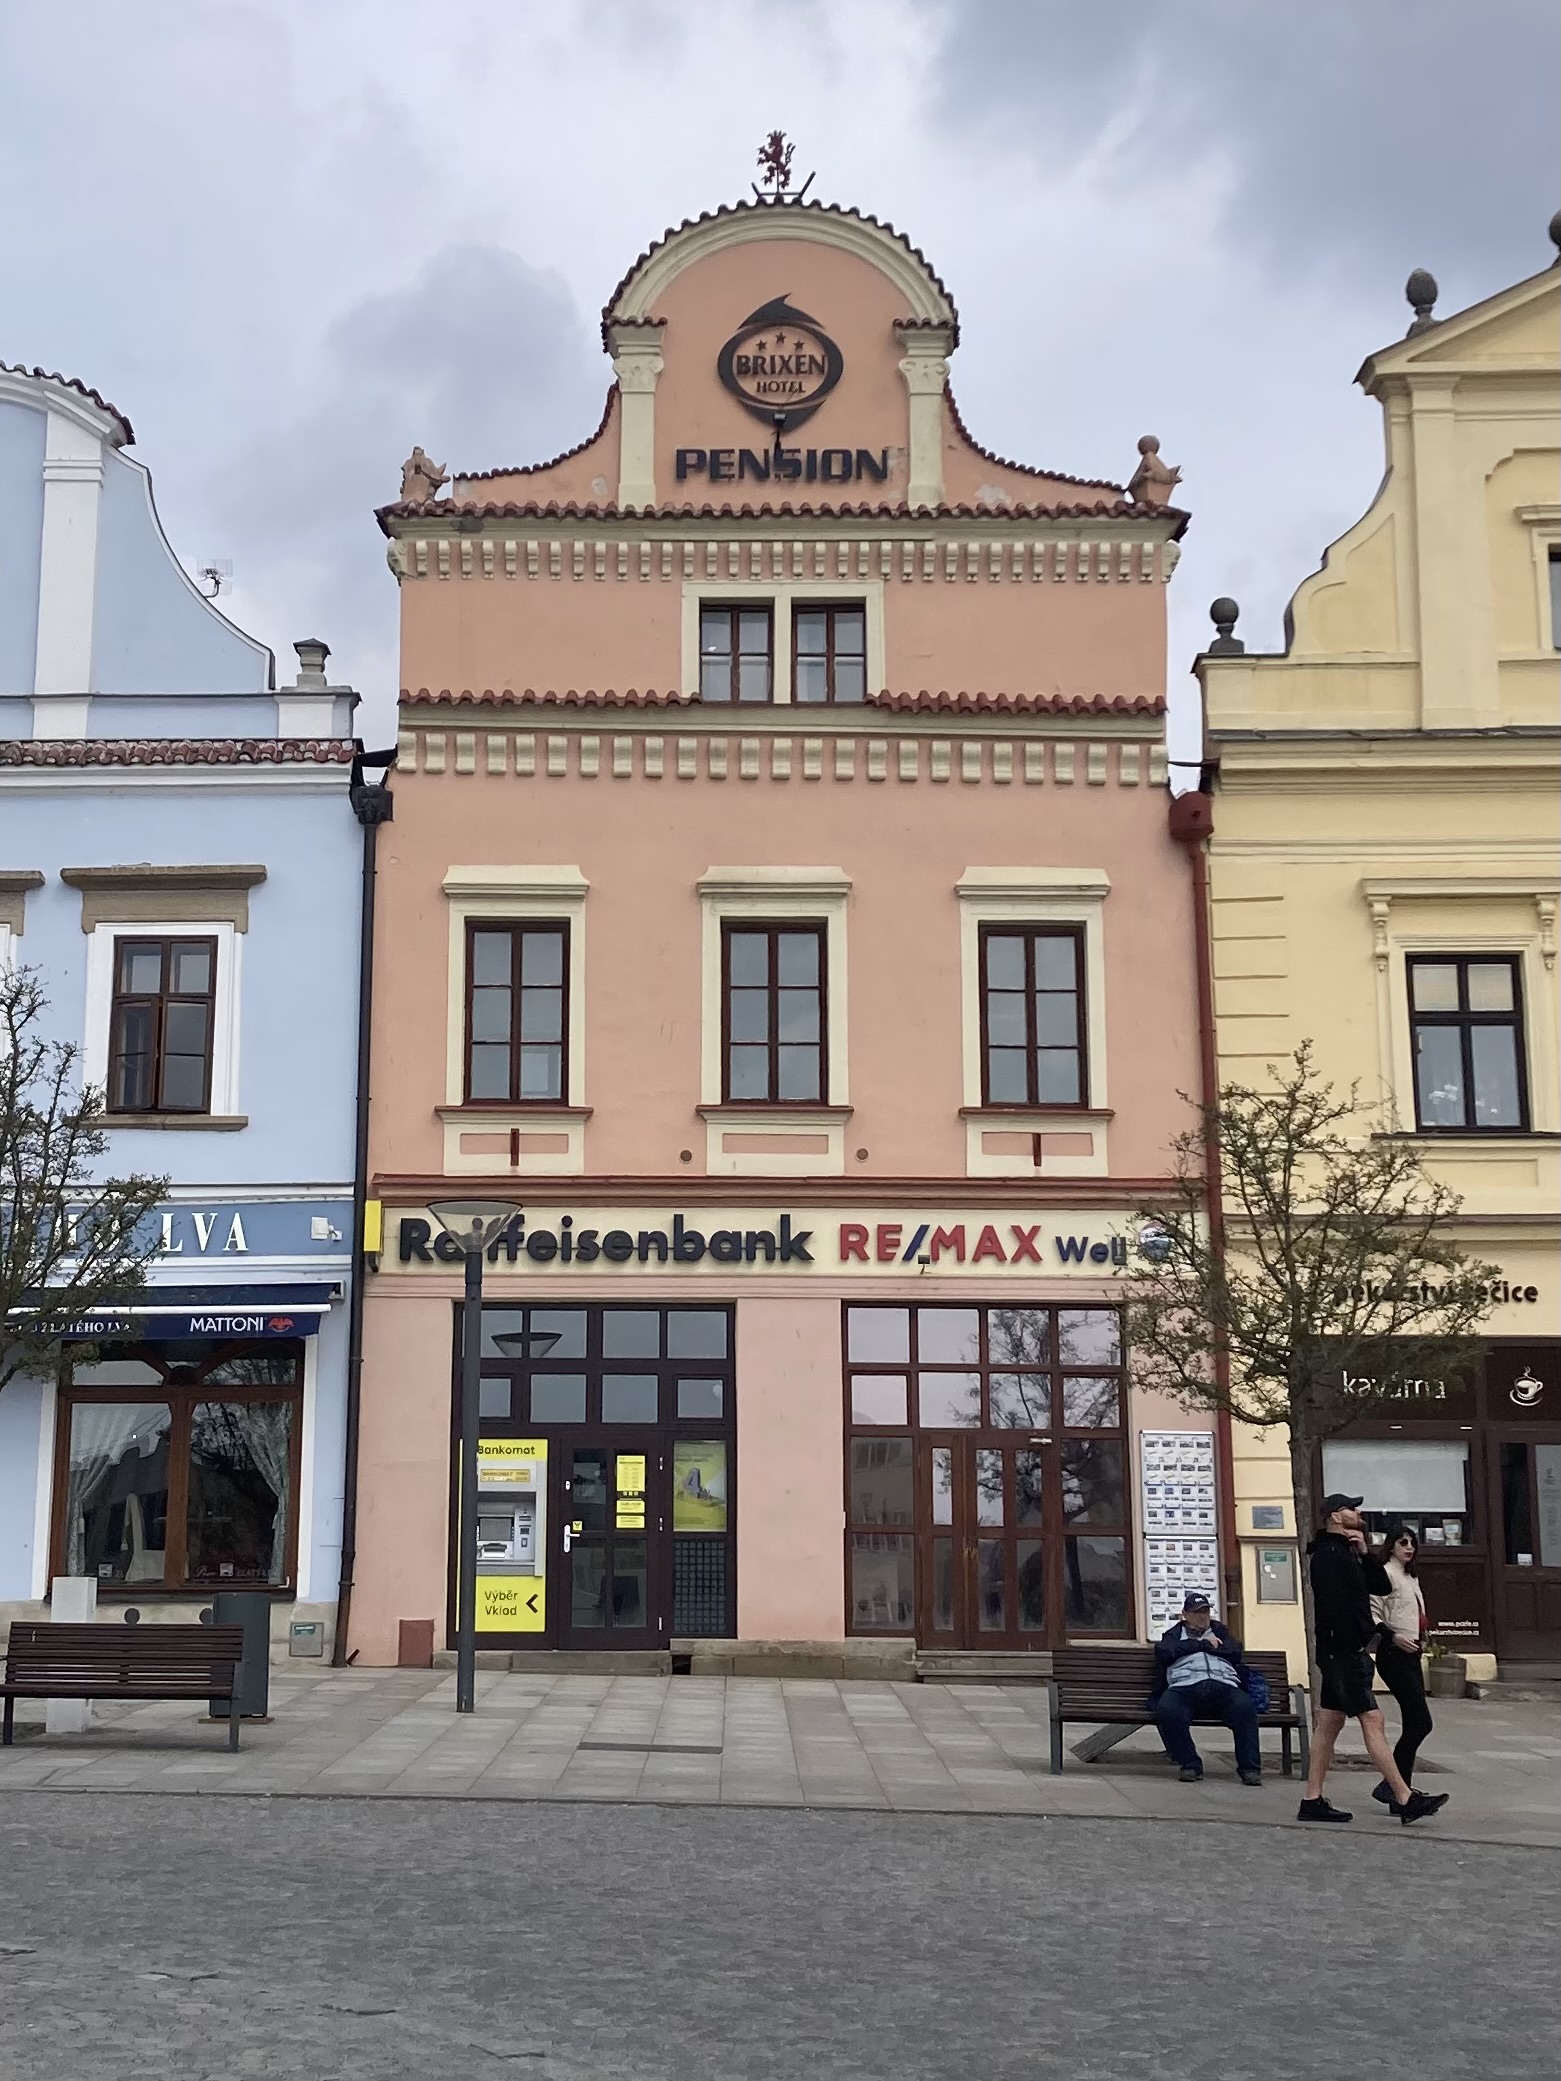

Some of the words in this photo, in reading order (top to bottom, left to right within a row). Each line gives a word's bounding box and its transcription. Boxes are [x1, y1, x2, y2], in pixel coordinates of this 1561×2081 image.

[736, 354, 827, 376] BRIXEN
[756, 380, 807, 394] HOTEL
[676, 448, 888, 482] PENSION
[160, 1212, 250, 1252] LVA
[840, 1224, 1042, 1263] RE/MAX
[1463, 1280, 1539, 1303] ečice
[190, 1316, 264, 1332] MATTONI
[478, 1445, 536, 1455] Bankomat
[485, 1590, 518, 1603] Výběr
[485, 1605, 517, 1616] Vklad
